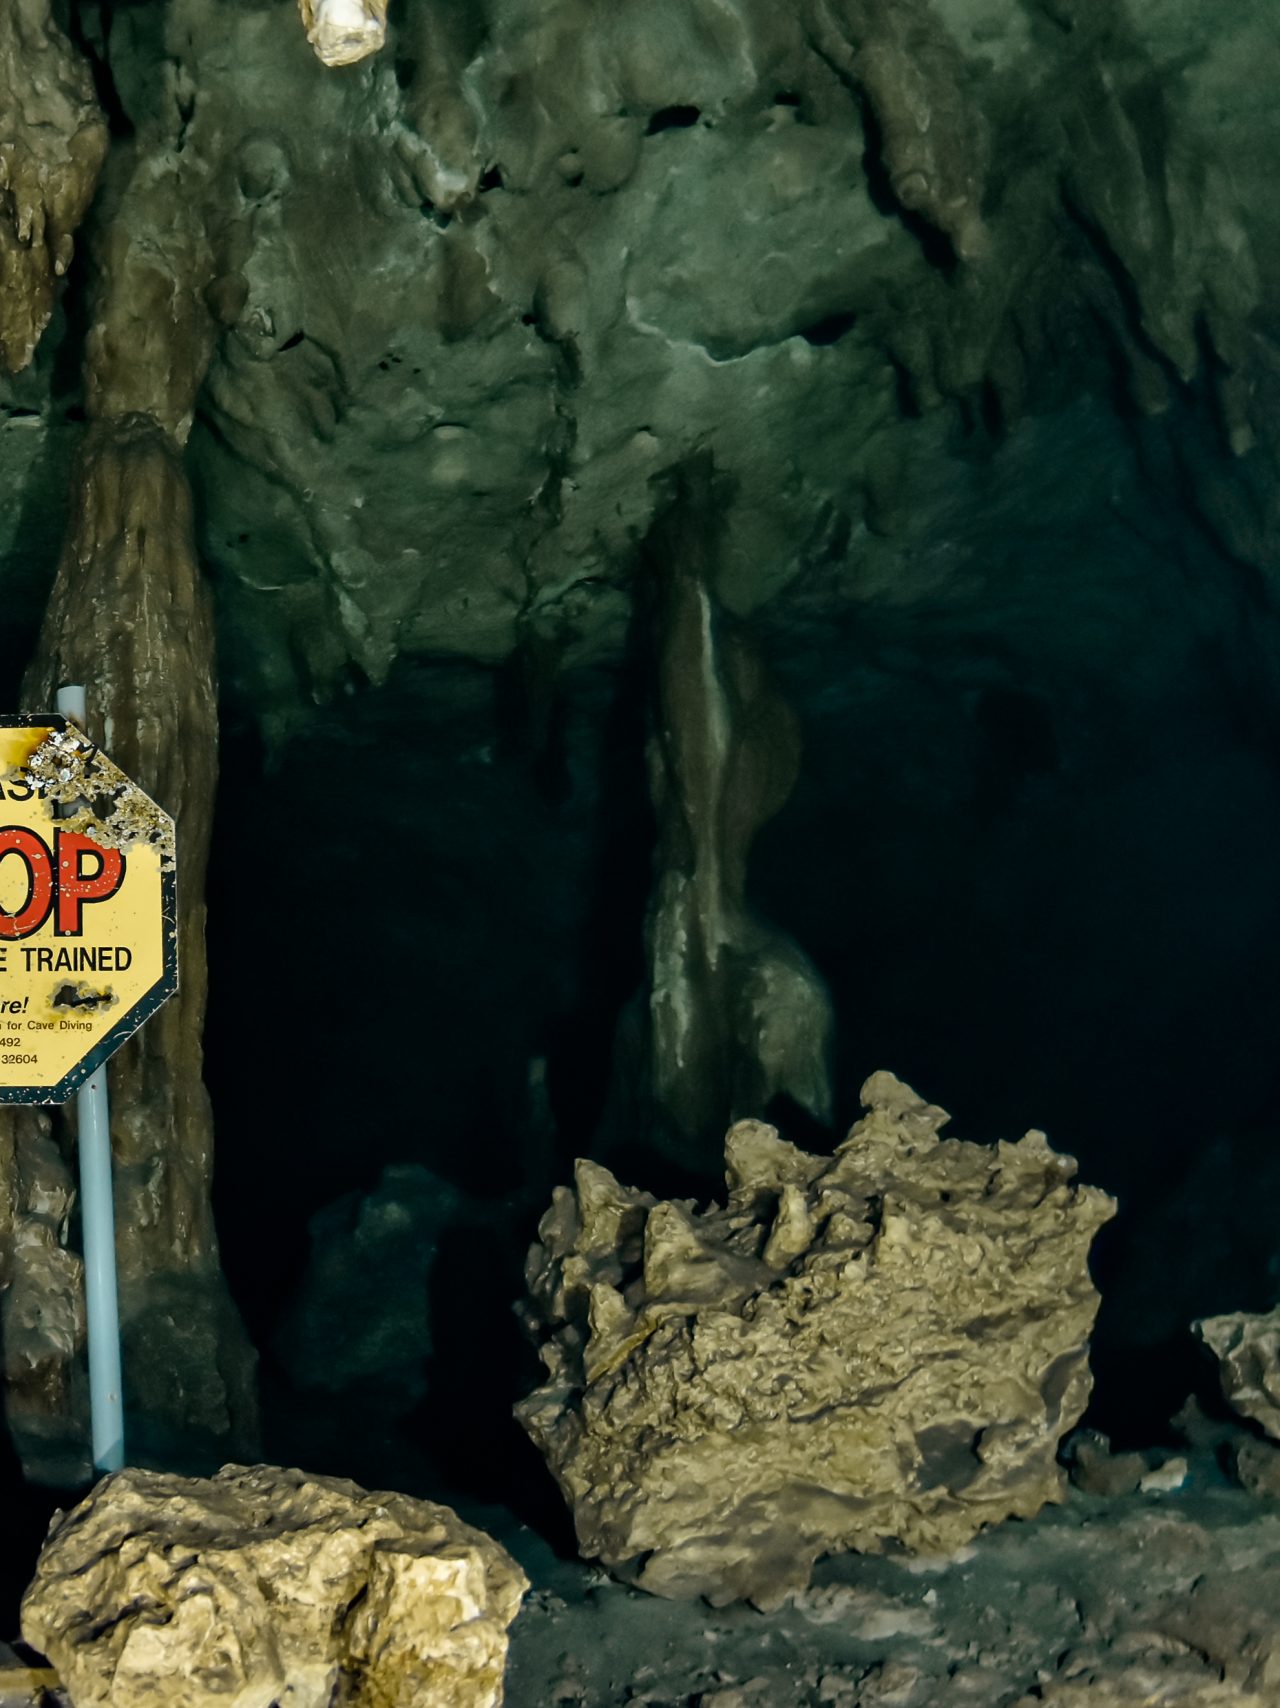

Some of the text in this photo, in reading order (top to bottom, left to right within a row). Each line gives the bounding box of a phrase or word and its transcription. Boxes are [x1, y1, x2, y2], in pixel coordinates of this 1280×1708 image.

[20, 946, 133, 972] TRAINED
[7, 1020, 22, 1030] for
[27, 1020, 55, 1031] Cave
[59, 1020, 93, 1032] Diving
[1, 1054, 38, 1065] 32604
